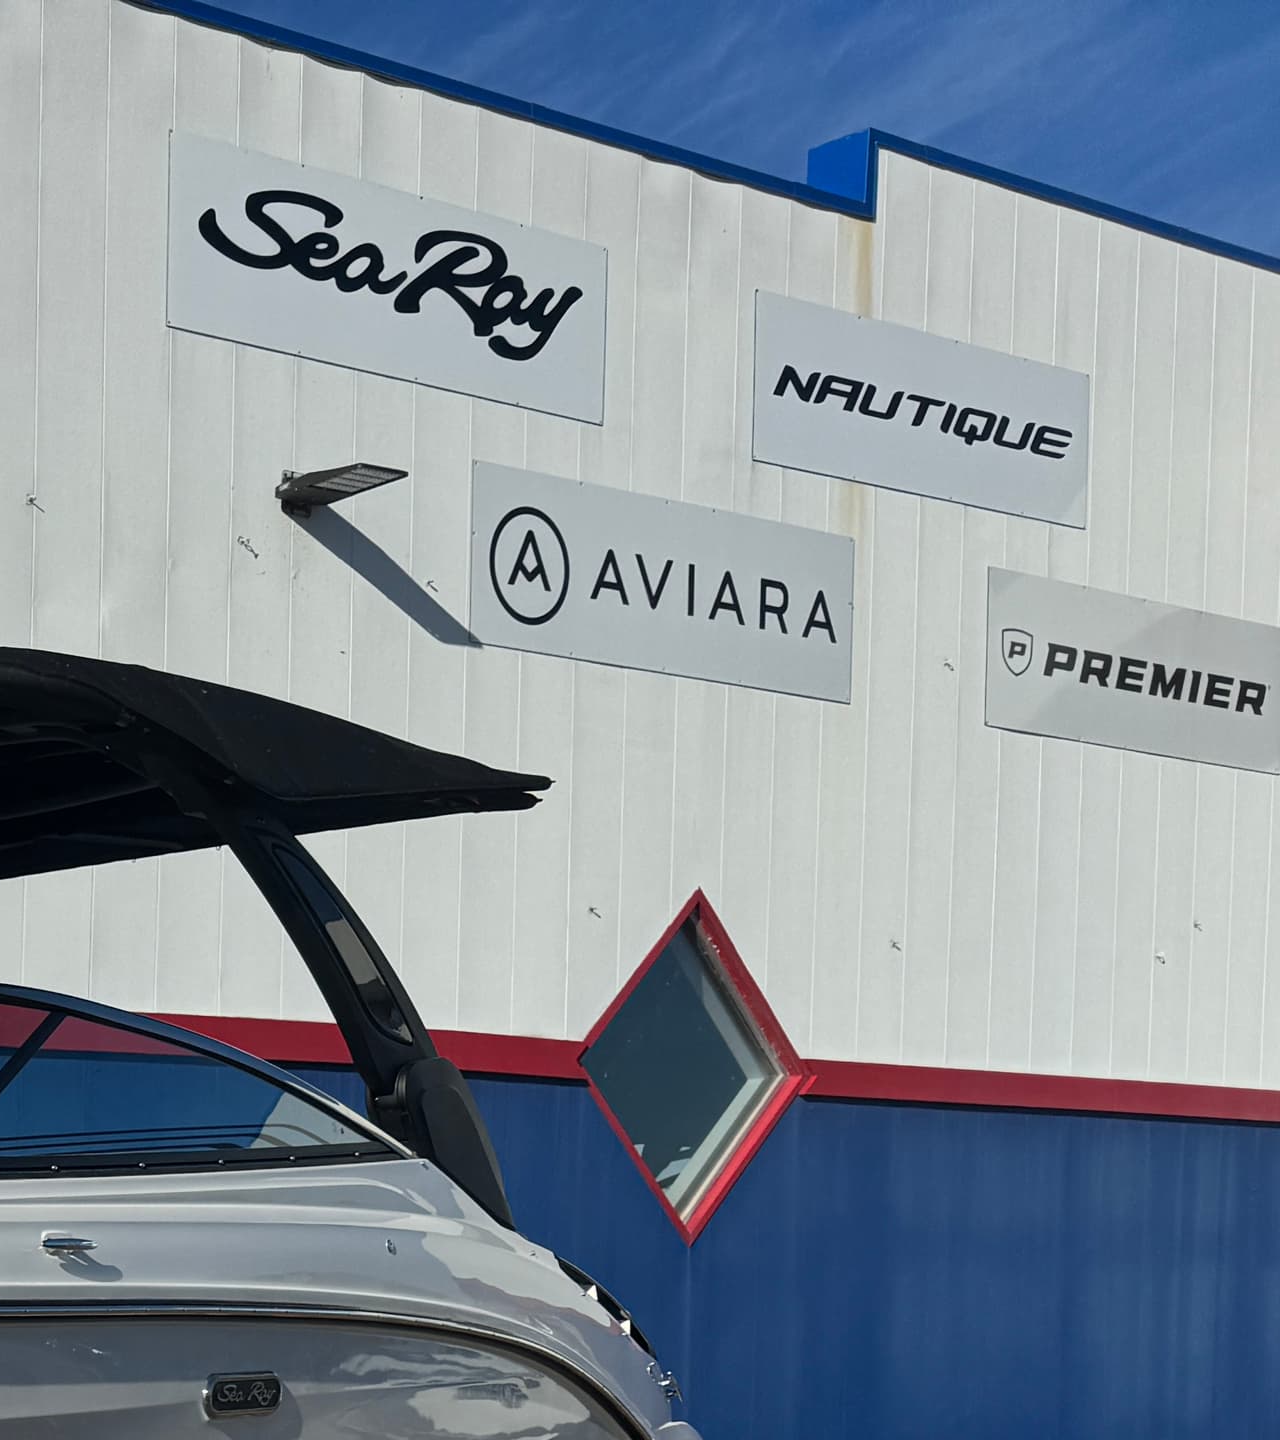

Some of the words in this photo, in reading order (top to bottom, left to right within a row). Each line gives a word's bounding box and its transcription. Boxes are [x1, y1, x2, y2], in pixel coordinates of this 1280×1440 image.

[198, 189, 408, 295] Sea
[393, 229, 584, 362] Ray
[772, 364, 1073, 460] NAUTIQUE
[590, 548, 837, 644] AVIARA
[1043, 642, 1267, 716] PREMIER
